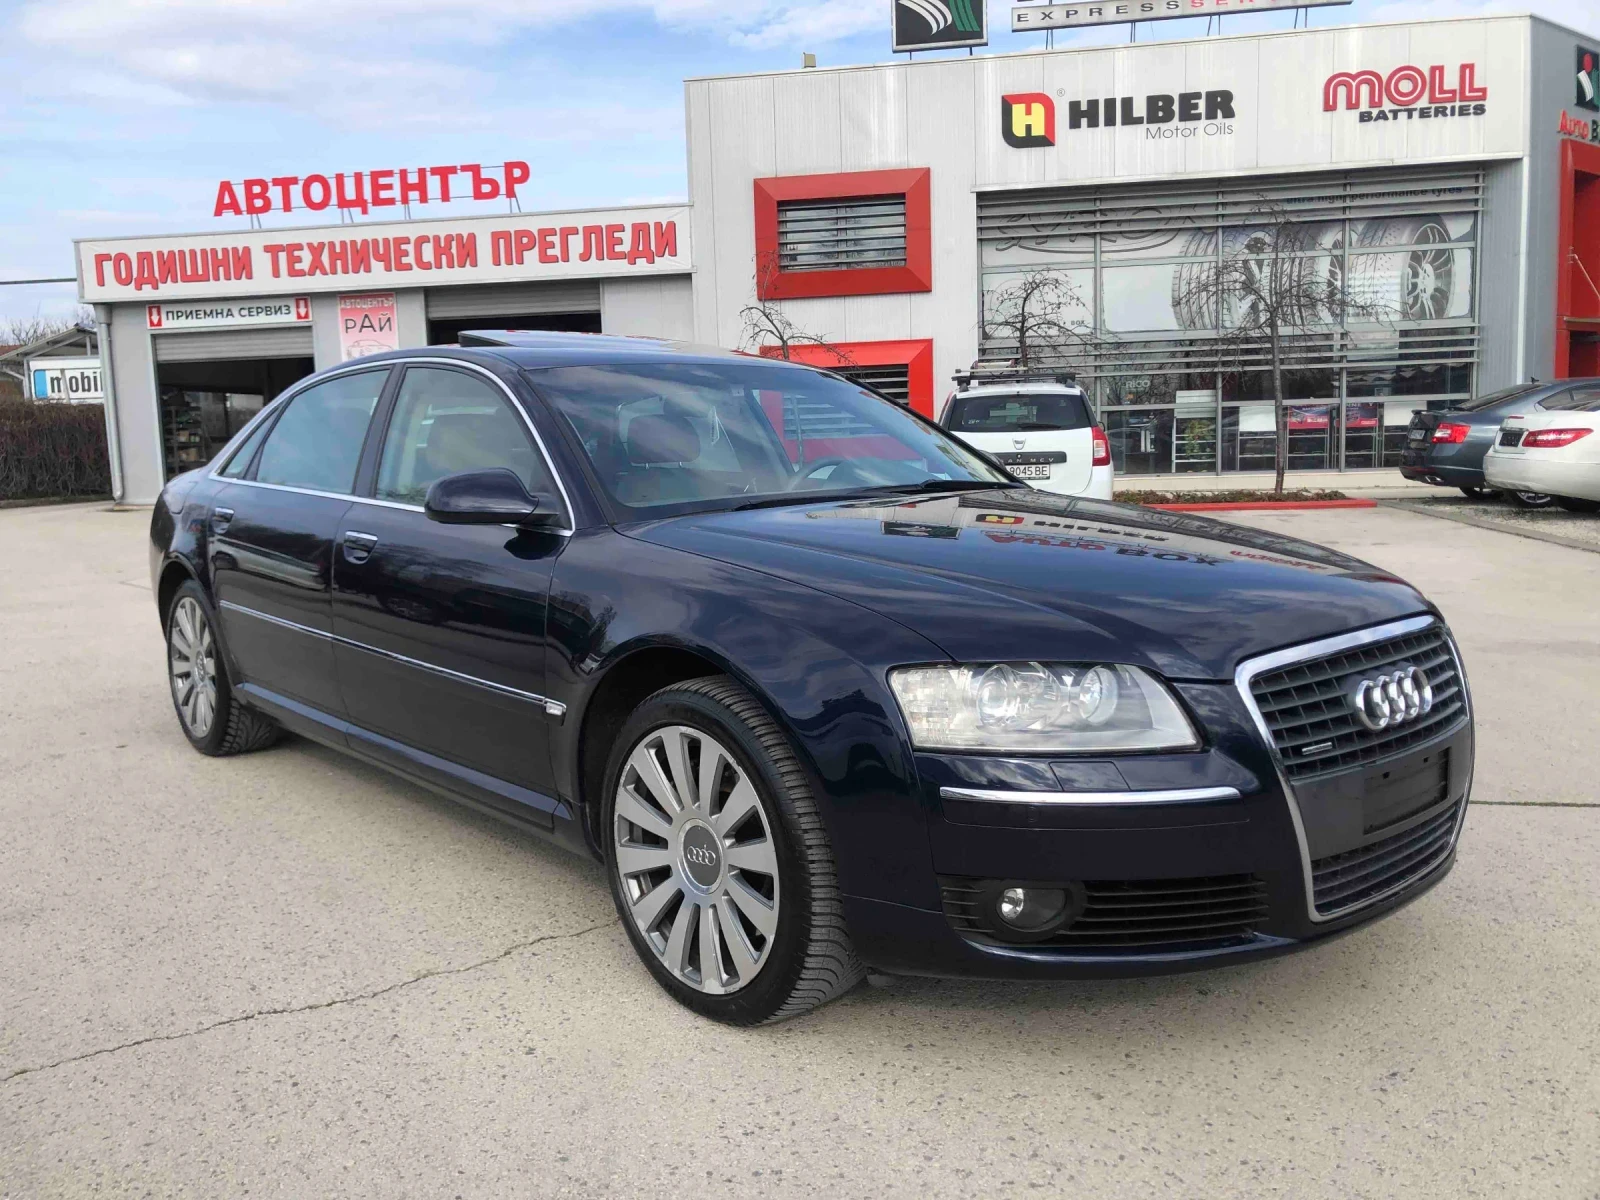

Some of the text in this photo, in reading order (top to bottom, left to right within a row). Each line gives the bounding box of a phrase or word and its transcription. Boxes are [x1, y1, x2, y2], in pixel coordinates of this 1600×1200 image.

[1016, 0, 1180, 23] EXPRESS
[1068, 89, 1236, 130] HILBER
[1358, 103, 1487, 123] BATTERIES
[1145, 122, 1235, 140] Motor Oils
[213, 160, 531, 217] АВТОЦЕНТЪР
[94, 220, 678, 291] ГОДИШНИ ТЕХНИЧЕСКИ ПРЕГЛЕДИ
[165, 304, 292, 321] ПРИЕМНА СЕРВИЗ
[339, 297, 396, 311] АВТОЦЕНТЪР
[344, 313, 393, 334] РАЙ
